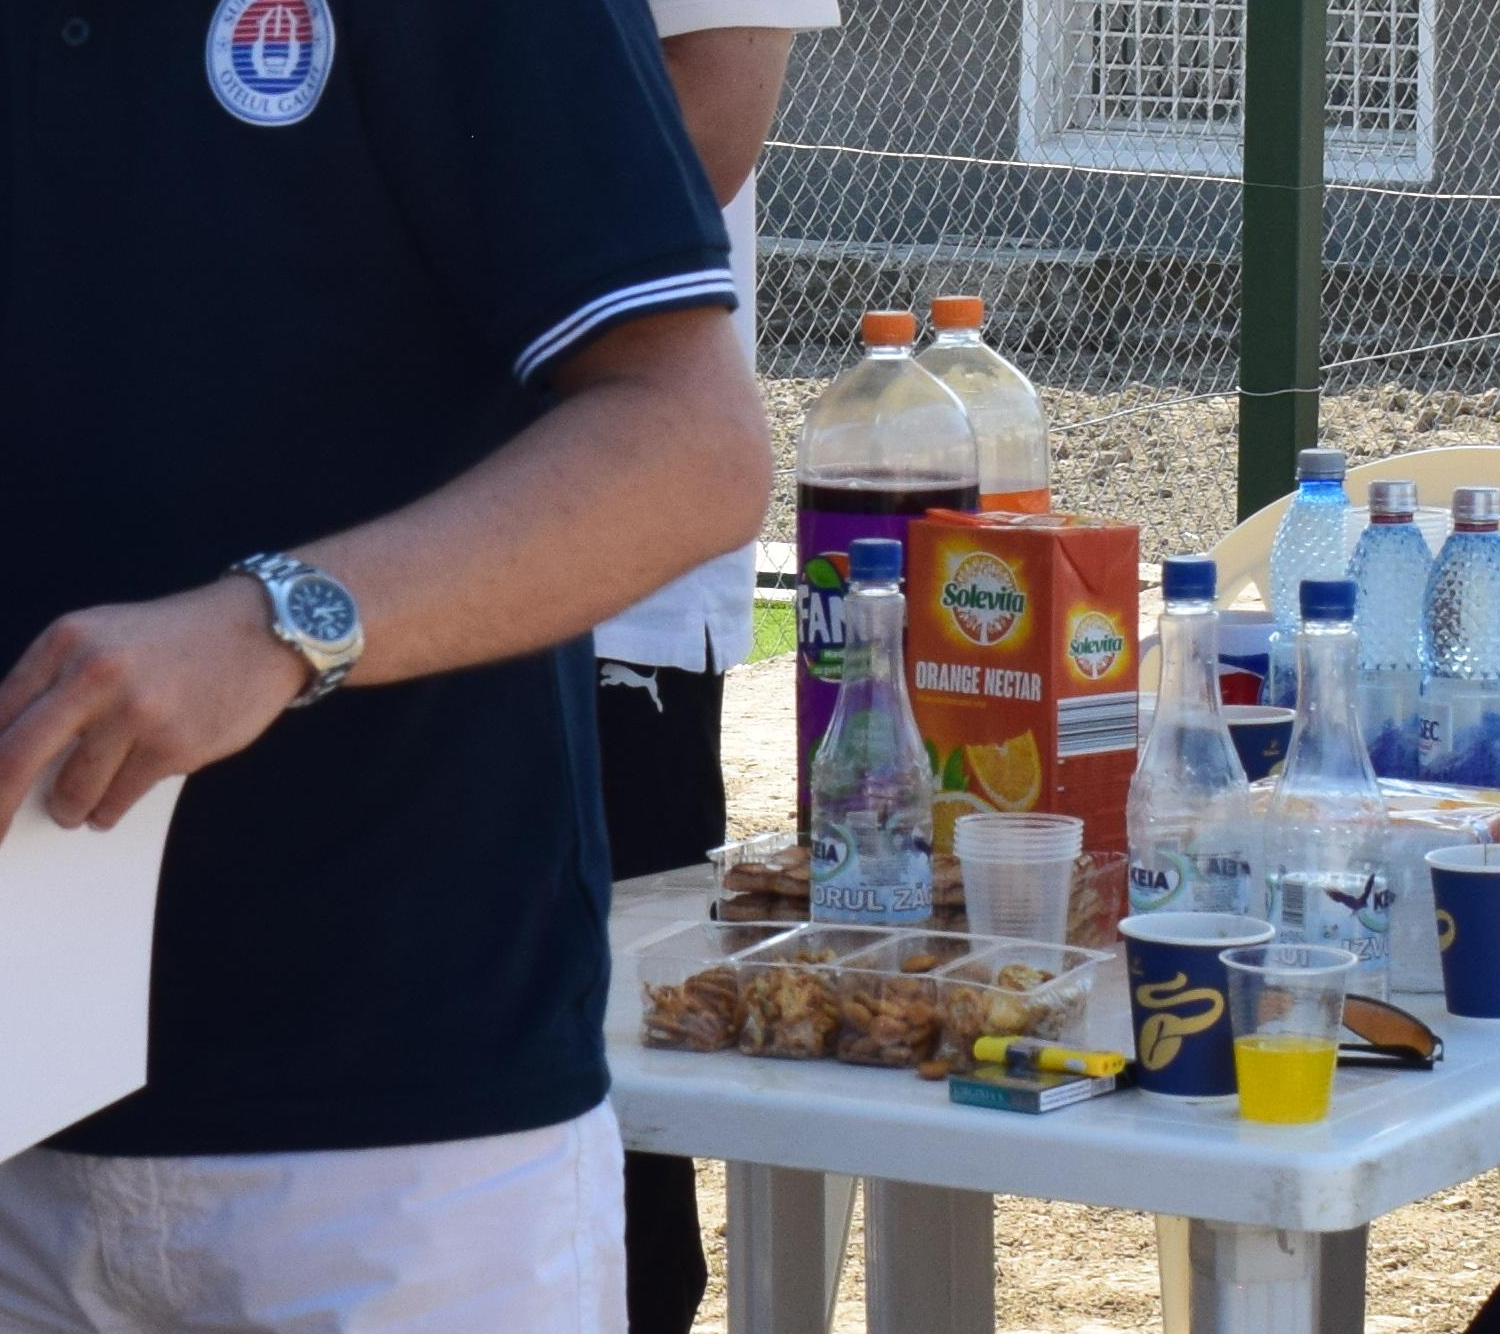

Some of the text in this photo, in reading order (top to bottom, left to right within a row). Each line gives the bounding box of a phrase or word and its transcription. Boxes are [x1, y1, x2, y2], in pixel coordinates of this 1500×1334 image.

[942, 582, 1027, 615] Solevita
[1069, 634, 1124, 658] Solevita
[915, 660, 981, 695] ORANGE
[984, 669, 1042, 702] NECTAR
